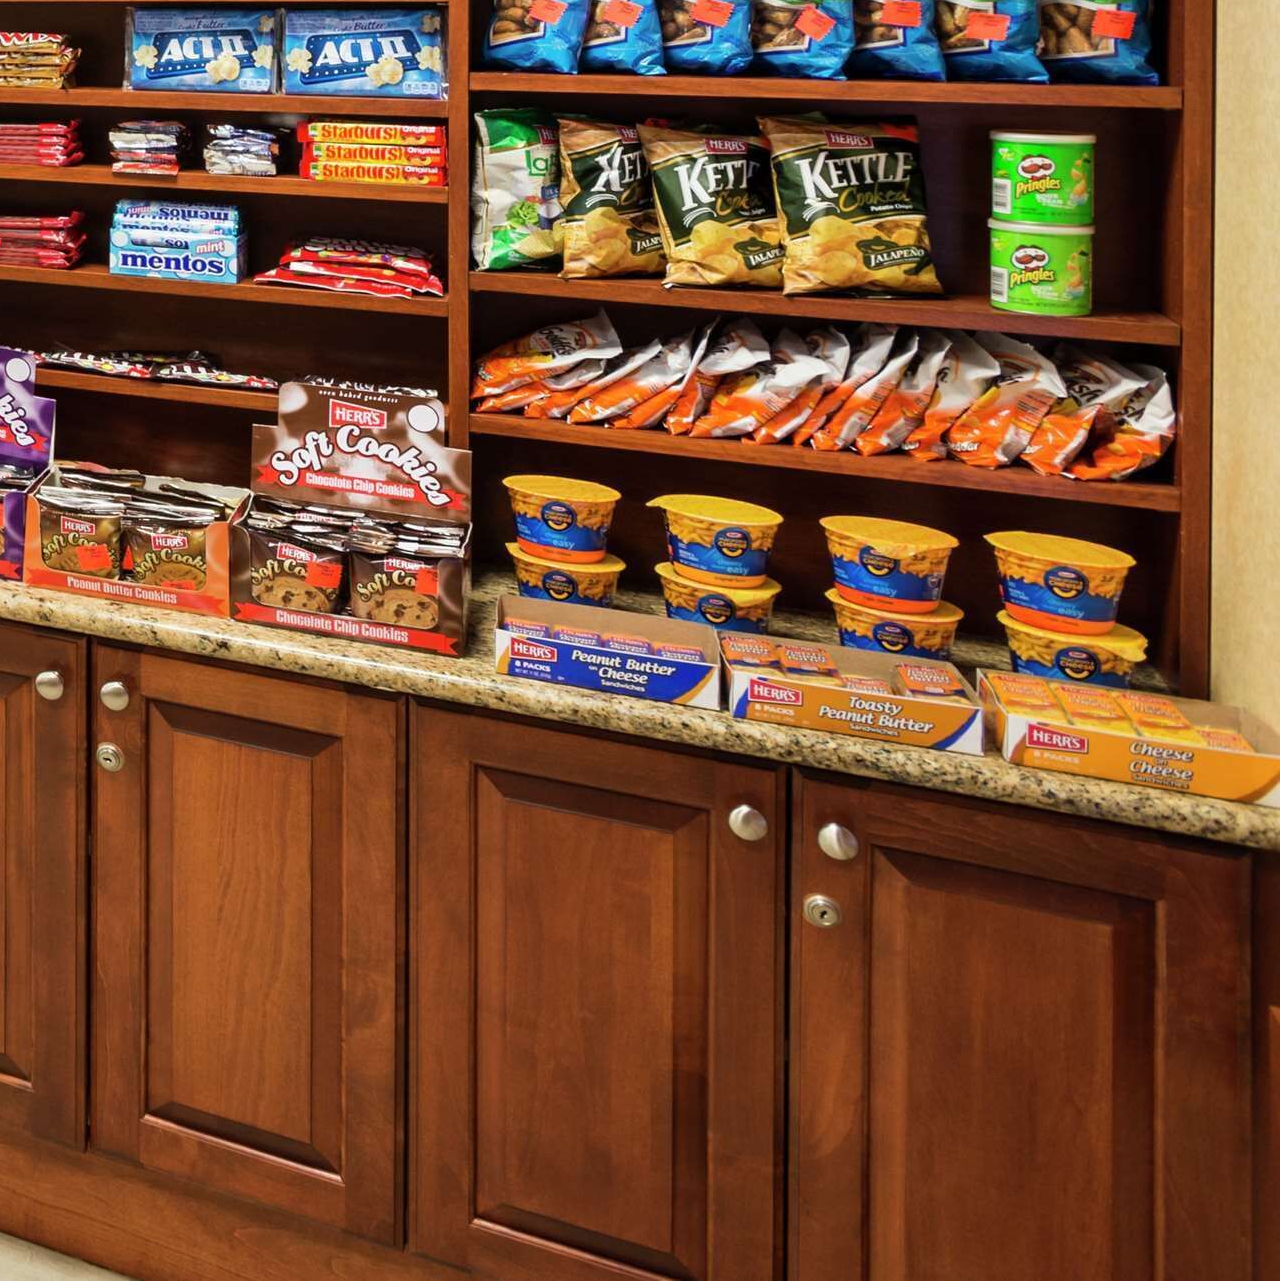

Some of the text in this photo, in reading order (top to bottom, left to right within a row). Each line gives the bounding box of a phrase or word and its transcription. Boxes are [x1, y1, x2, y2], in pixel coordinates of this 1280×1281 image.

[353, 21, 386, 31] Butter
[161, 36, 249, 63] ACT II
[315, 36, 412, 66] ACT II
[403, 125, 435, 133] Original
[709, 139, 745, 151] HERR'S
[830, 133, 869, 146] HERR'S
[407, 147, 440, 155] Original
[404, 166, 438, 174] Original
[796, 152, 913, 205] KETTLE
[1016, 178, 1061, 198] Pringles
[839, 185, 910, 211] Cooked
[195, 240, 225, 254] mint
[120, 251, 225, 275] mentos
[870, 249, 924, 267] JALAPEÑO
[1010, 269, 1054, 288] Pringles
[335, 408, 380, 425] HERR'S
[271, 425, 451, 506] Soft Cookies
[305, 473, 415, 498] Chocolate Chip Cookies
[64, 519, 93, 533] HERR'S
[155, 537, 185, 548] HERR'S
[251, 560, 281, 584] Soft
[67, 577, 177, 605] Peanut Butter Cookies
[357, 573, 390, 601] Soft
[276, 610, 409, 642] Chocolate Chip Cookies
[513, 641, 552, 659] HERR'S
[524, 662, 551, 672] PACKS
[571, 650, 676, 677] Peanut Butter
[599, 667, 648, 685] Cheese
[601, 679, 645, 693] Sandwiches
[753, 684, 796, 702] HERR'S
[849, 697, 902, 714] Toasty
[819, 706, 933, 733] Peanut Butter
[1032, 730, 1081, 749] HERR'S
[1130, 742, 1194, 762] Cheese
[1130, 761, 1193, 781] Cheese
